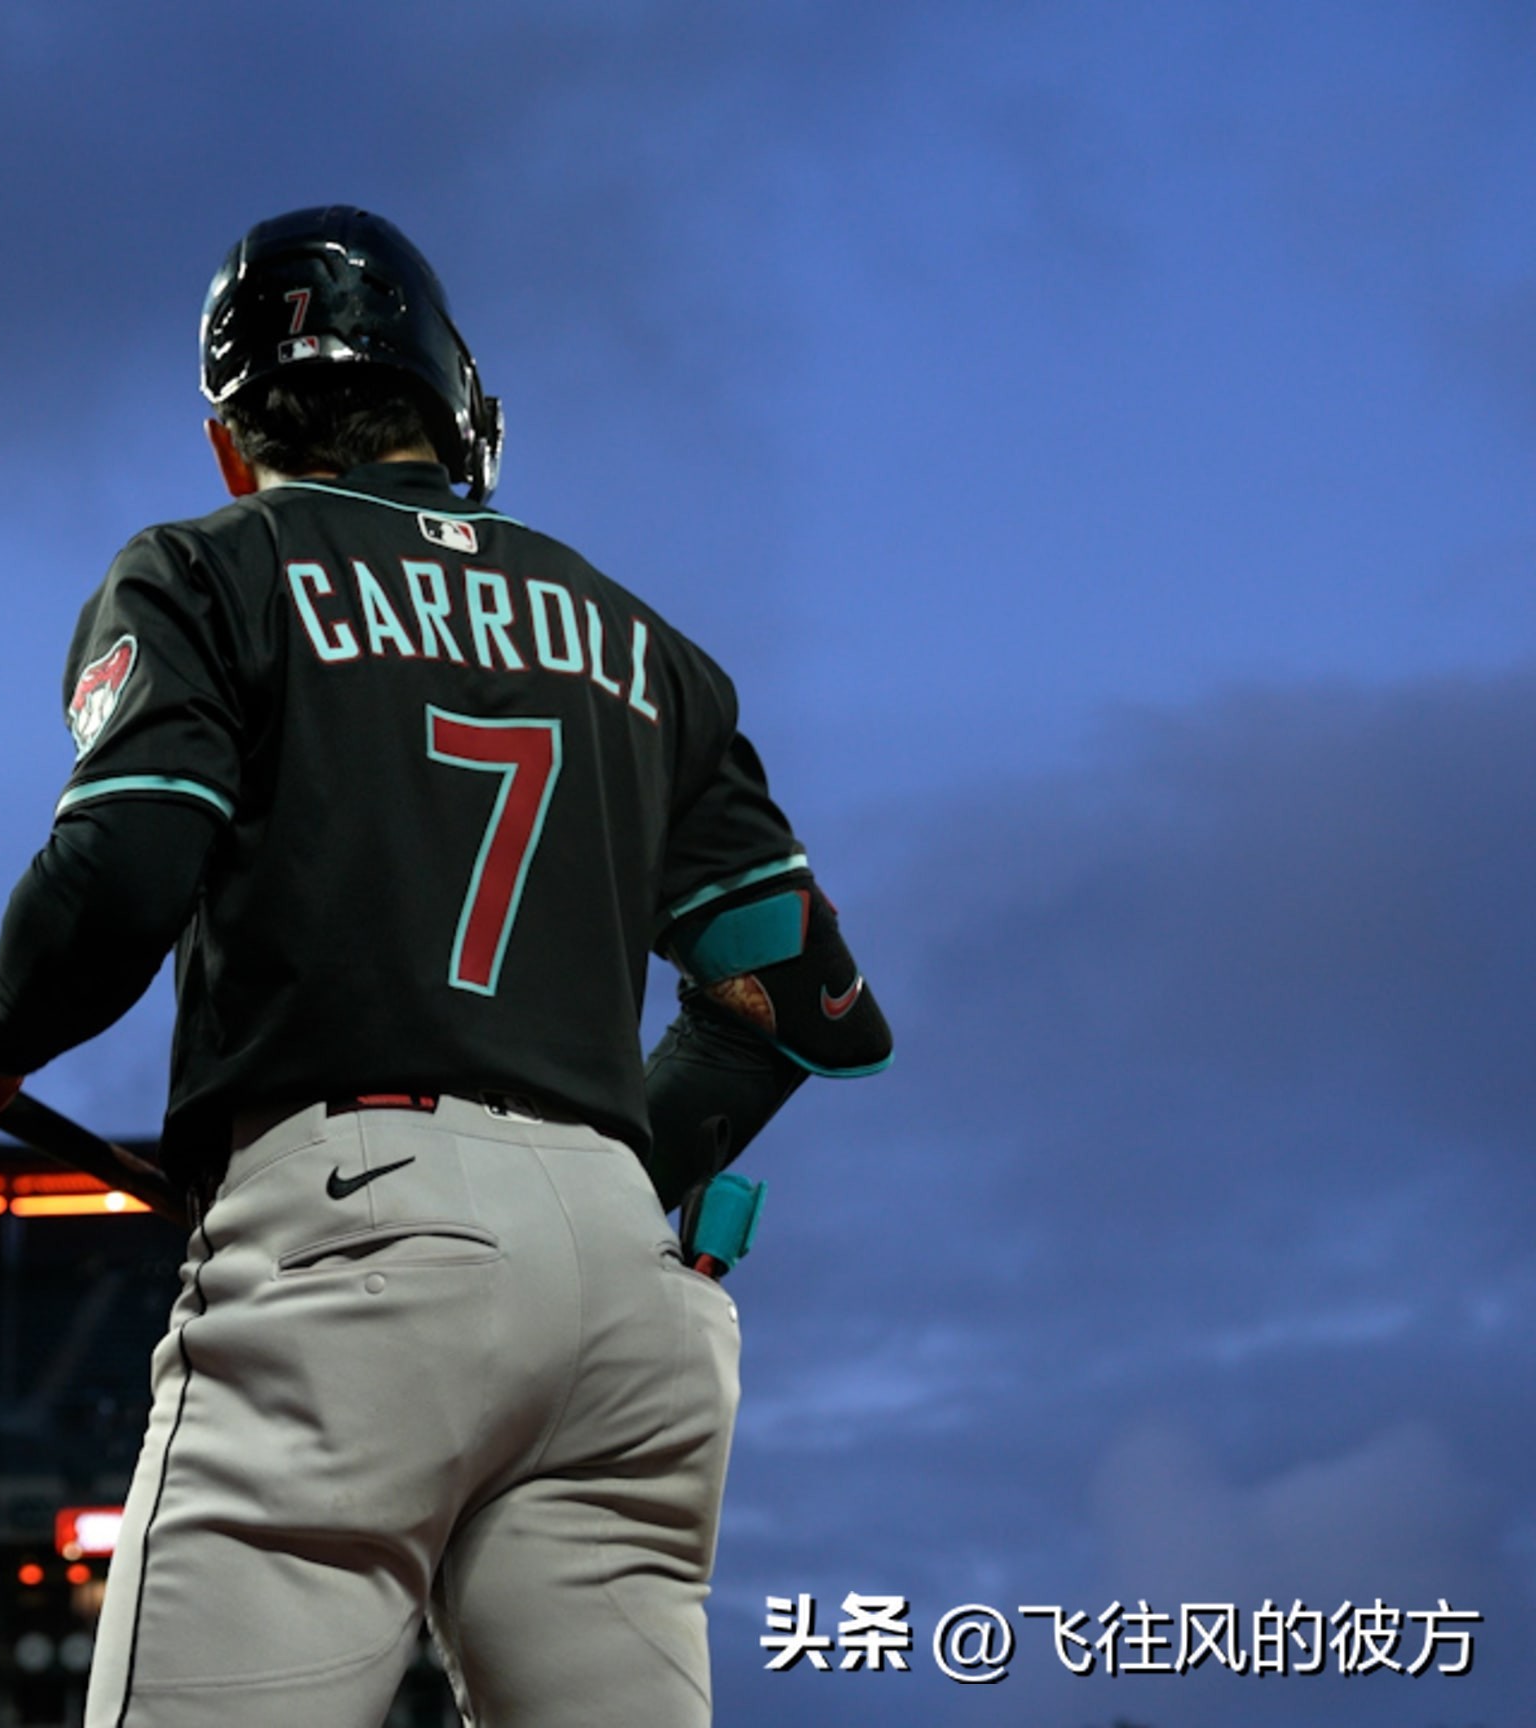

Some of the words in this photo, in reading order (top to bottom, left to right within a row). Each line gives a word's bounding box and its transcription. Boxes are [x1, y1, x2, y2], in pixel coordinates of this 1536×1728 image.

[284, 288, 311, 334] 7
[286, 558, 658, 722] CARROLL
[425, 703, 562, 997] 7
